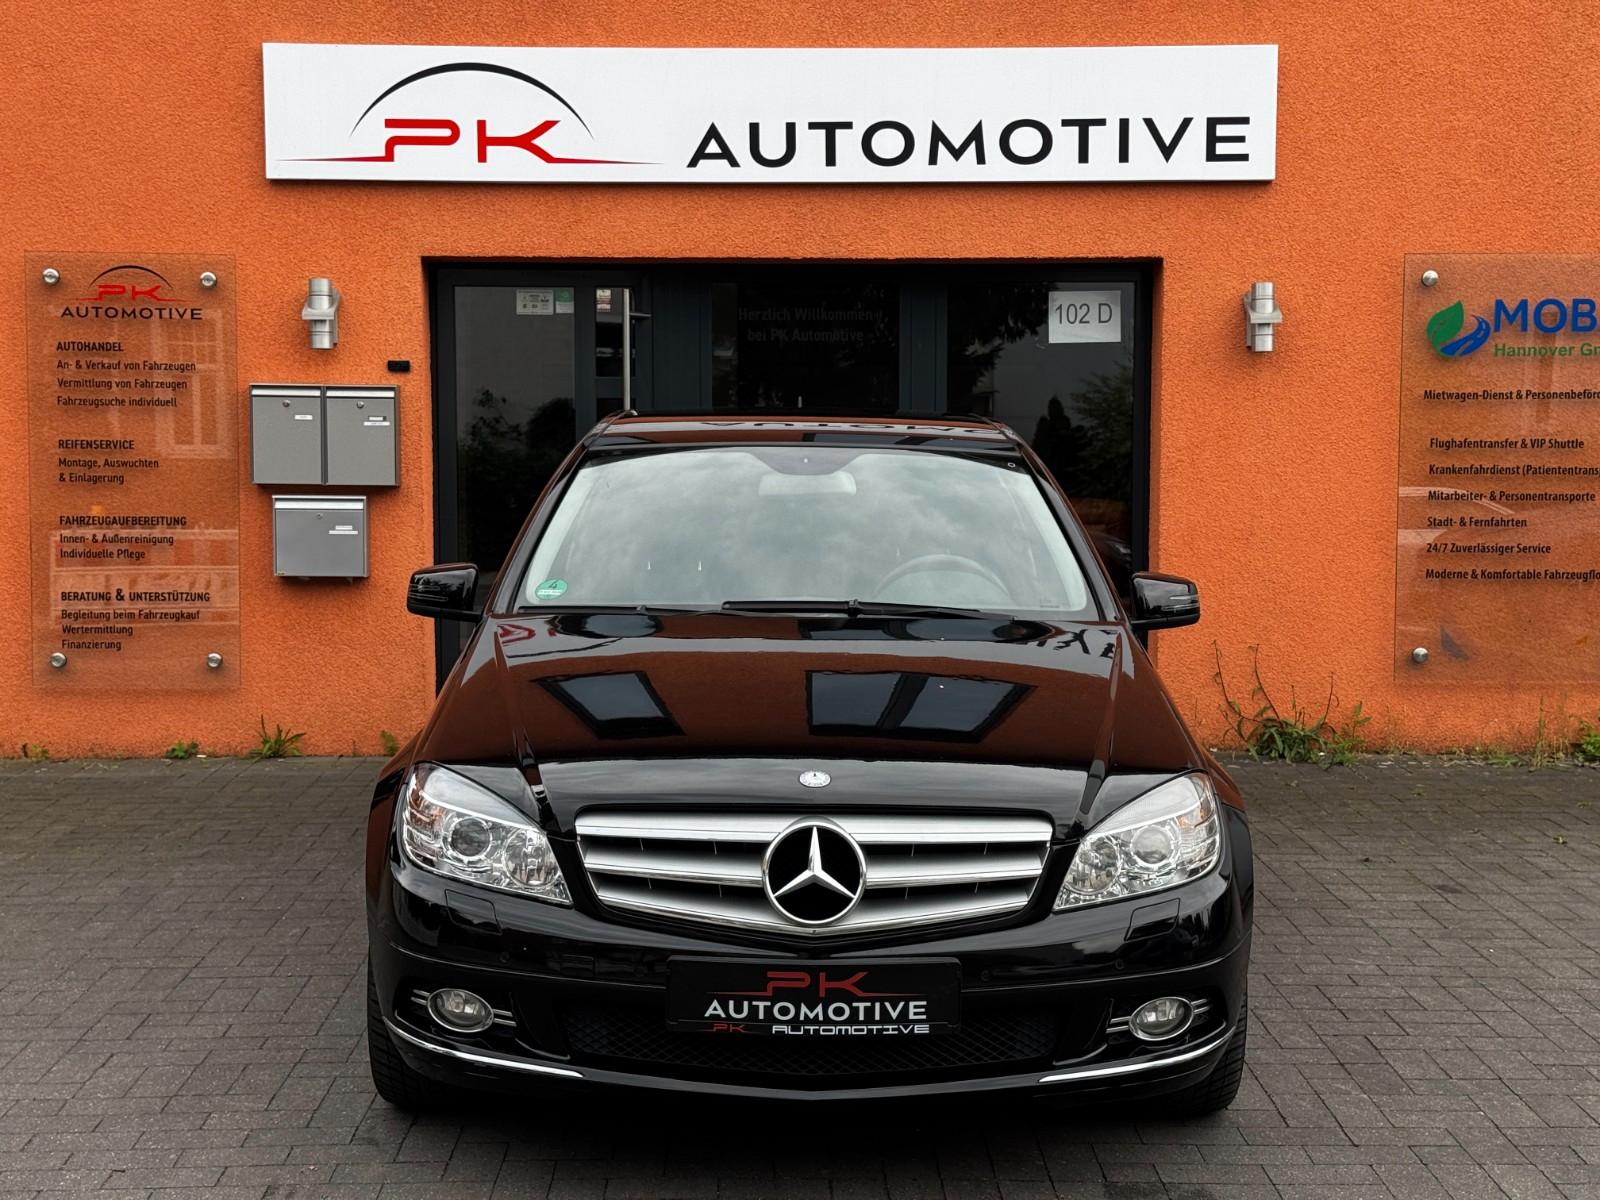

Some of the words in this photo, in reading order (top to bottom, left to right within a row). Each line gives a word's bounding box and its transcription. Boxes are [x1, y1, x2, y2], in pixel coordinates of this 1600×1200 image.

[384, 118, 562, 164] PK
[687, 116, 1251, 168] AUTOMOTIVE
[97, 284, 161, 302] PK
[61, 306, 203, 320] AUTOMOTIVE
[738, 307, 791, 321] Herzlich
[794, 306, 873, 321] Willkommen
[1055, 303, 1090, 325] 102
[1098, 302, 1113, 324] D
[1493, 298, 1598, 334] MOB
[748, 328, 766, 341] bei
[792, 328, 865, 342] Automotive
[56, 341, 124, 352] AUTOHANDEL
[1494, 343, 1575, 358] Hannover
[57, 360, 73, 370] An-
[75, 360, 82, 370] &
[85, 360, 121, 371] Verkauf
[124, 362, 140, 371] von
[143, 360, 196, 373] Fahrzeugen
[57, 378, 113, 390] Vermittlung
[115, 380, 131, 389] von
[134, 379, 188, 391] Fahrzeugen
[57, 396, 126, 408] Fahrzeugsuche
[128, 396, 177, 408] individuell
[1424, 389, 1513, 402] Mietwagen-Dienst
[1516, 390, 1523, 400] &
[58, 439, 135, 450] REIFENSERVICE
[1430, 438, 1518, 450] Flughafentransfer
[1520, 438, 1528, 449] &
[1530, 438, 1546, 449] VIP
[1548, 438, 1584, 449] Shuttle
[58, 458, 101, 469] Montage,
[103, 458, 159, 468] Auswuchten
[1429, 464, 1520, 475] Krankenfahrdienst
[1522, 464, 1600, 477] (Patiententrans
[58, 473, 66, 482] &
[69, 473, 125, 485] Einlagerung
[1428, 490, 1487, 501] Mitarbeiter-
[1489, 491, 1497, 501] &
[1499, 490, 1596, 504] Personentransporte
[59, 515, 187, 527] FAHRZEUGAUFBEREITUNG
[1427, 516, 1456, 527] Stadt-
[1459, 517, 1467, 527] &
[1469, 516, 1527, 527] Fernfahrten
[60, 534, 89, 544] Innen-
[92, 534, 99, 544] &
[102, 534, 174, 545] Außenreinigung
[60, 549, 115, 559] Individuelle
[117, 549, 146, 560] Pflege
[1426, 543, 1448, 554] 24/7
[1450, 542, 1516, 555] Zuverlässiger
[1517, 543, 1551, 554] Service
[1426, 569, 1468, 579] Moderne
[1471, 569, 1478, 579] &
[1480, 569, 1542, 579] Komfortable
[61, 591, 112, 602] BERATUNG
[115, 588, 125, 602] &
[129, 590, 210, 602] UNTERSTÜTZUNG
[61, 610, 111, 622] Begleitung
[113, 610, 135, 620] beim
[138, 610, 200, 622] Fahrzeugkauf
[62, 625, 133, 636] Wertermittlung
[62, 639, 122, 651] Finanzierung
[766, 971, 869, 997] PK
[704, 999, 927, 1021] AUTOMOTIVE
[772, 1024, 930, 1035] AUTOMOTIVE
